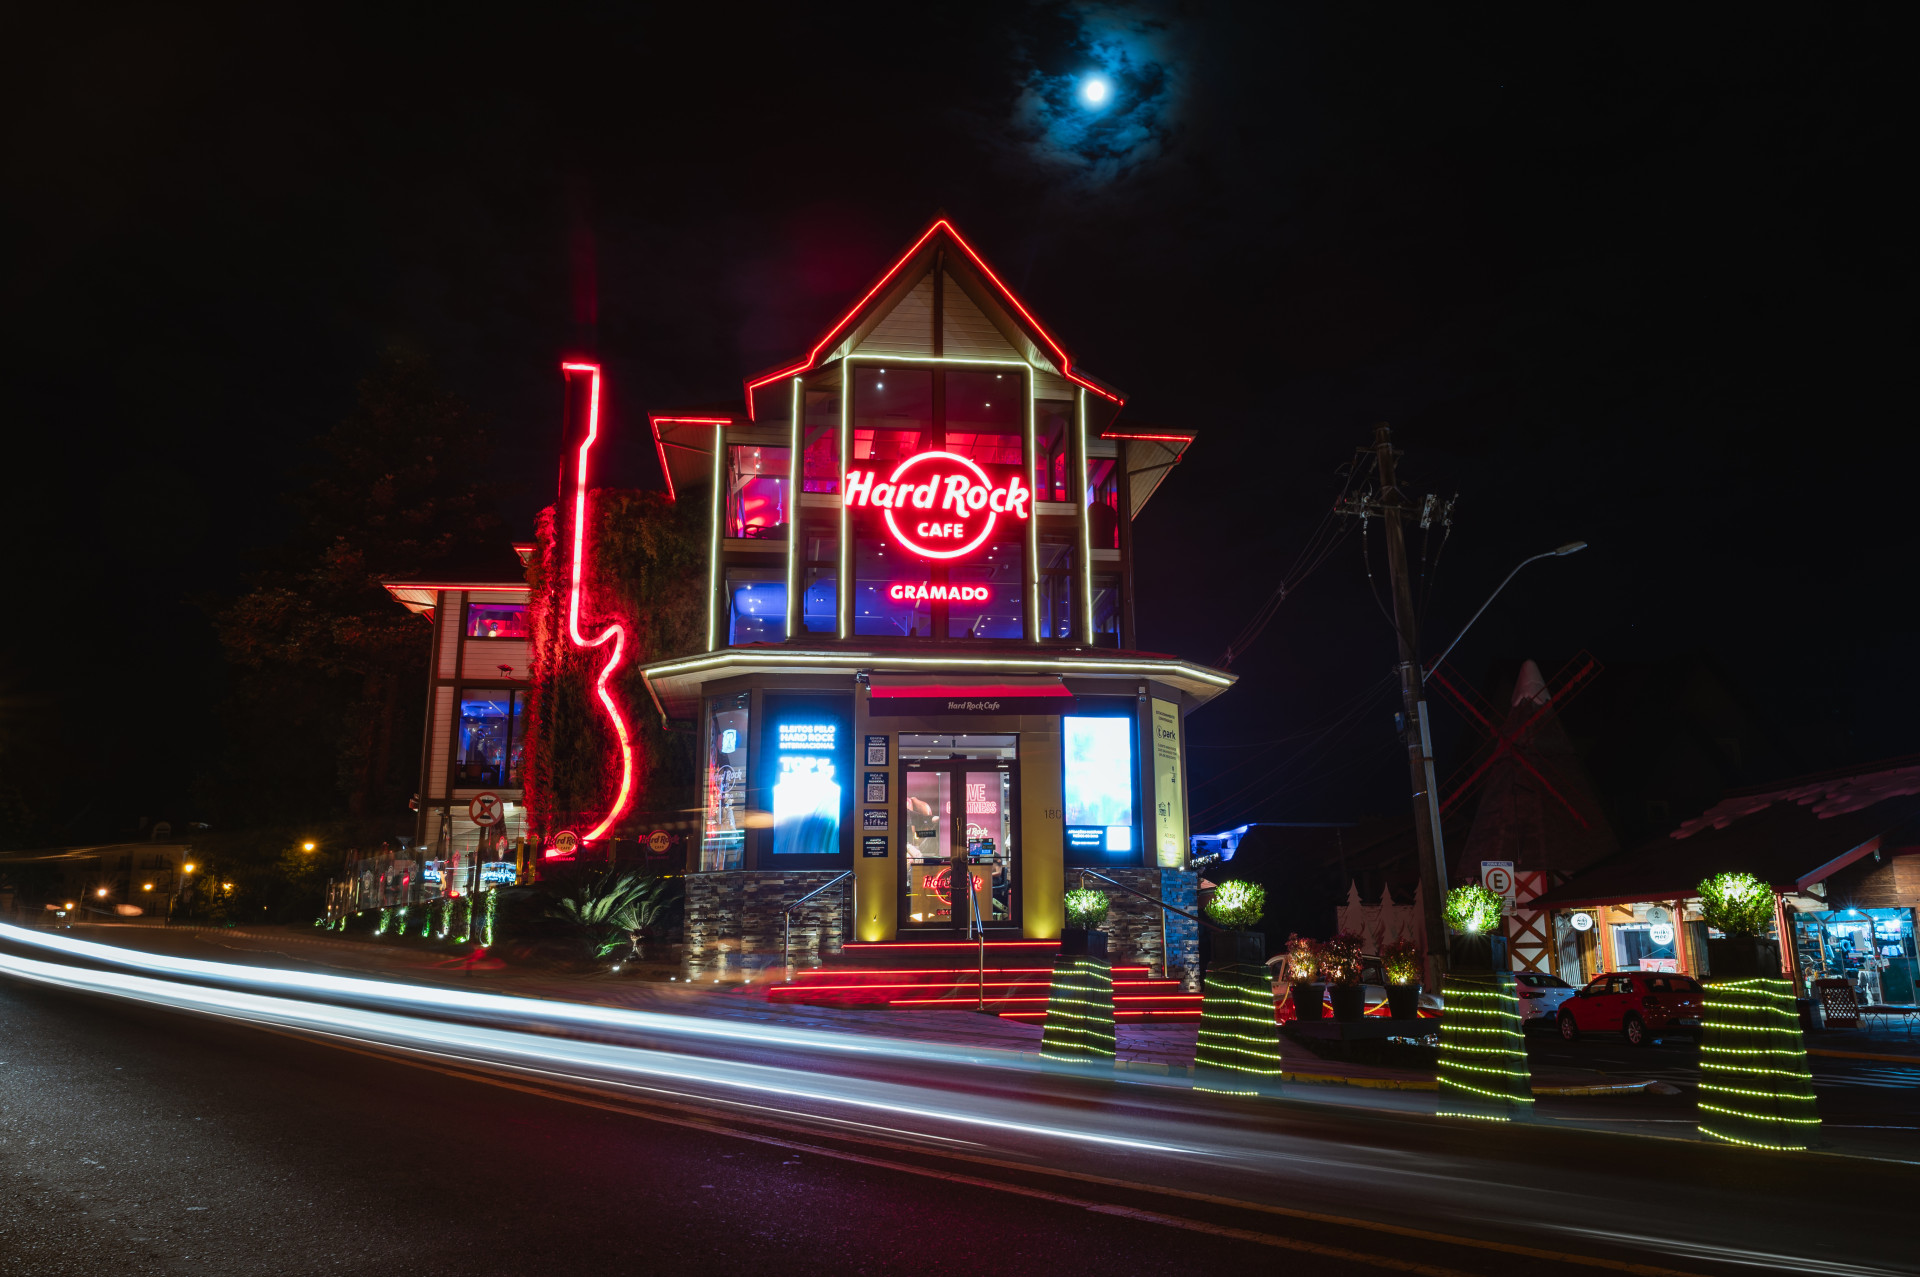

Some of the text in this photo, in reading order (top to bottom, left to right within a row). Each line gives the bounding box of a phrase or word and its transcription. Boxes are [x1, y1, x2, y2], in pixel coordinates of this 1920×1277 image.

[844, 470, 1029, 519] Hard Rock
[917, 522, 964, 538] CAFE
[890, 584, 989, 601] GRAMADO
[948, 701, 1001, 711] Hard Rock Cafe
[779, 725, 836, 733] ELEITOS PELO
[780, 734, 835, 742] HARD ROCK
[779, 742, 836, 750] INTERNACIONAL
[726, 768, 743, 782] Rock
[966, 783, 986, 801] IVE
[971, 827, 988, 837] Rock
[1493, 873, 1503, 889] E
